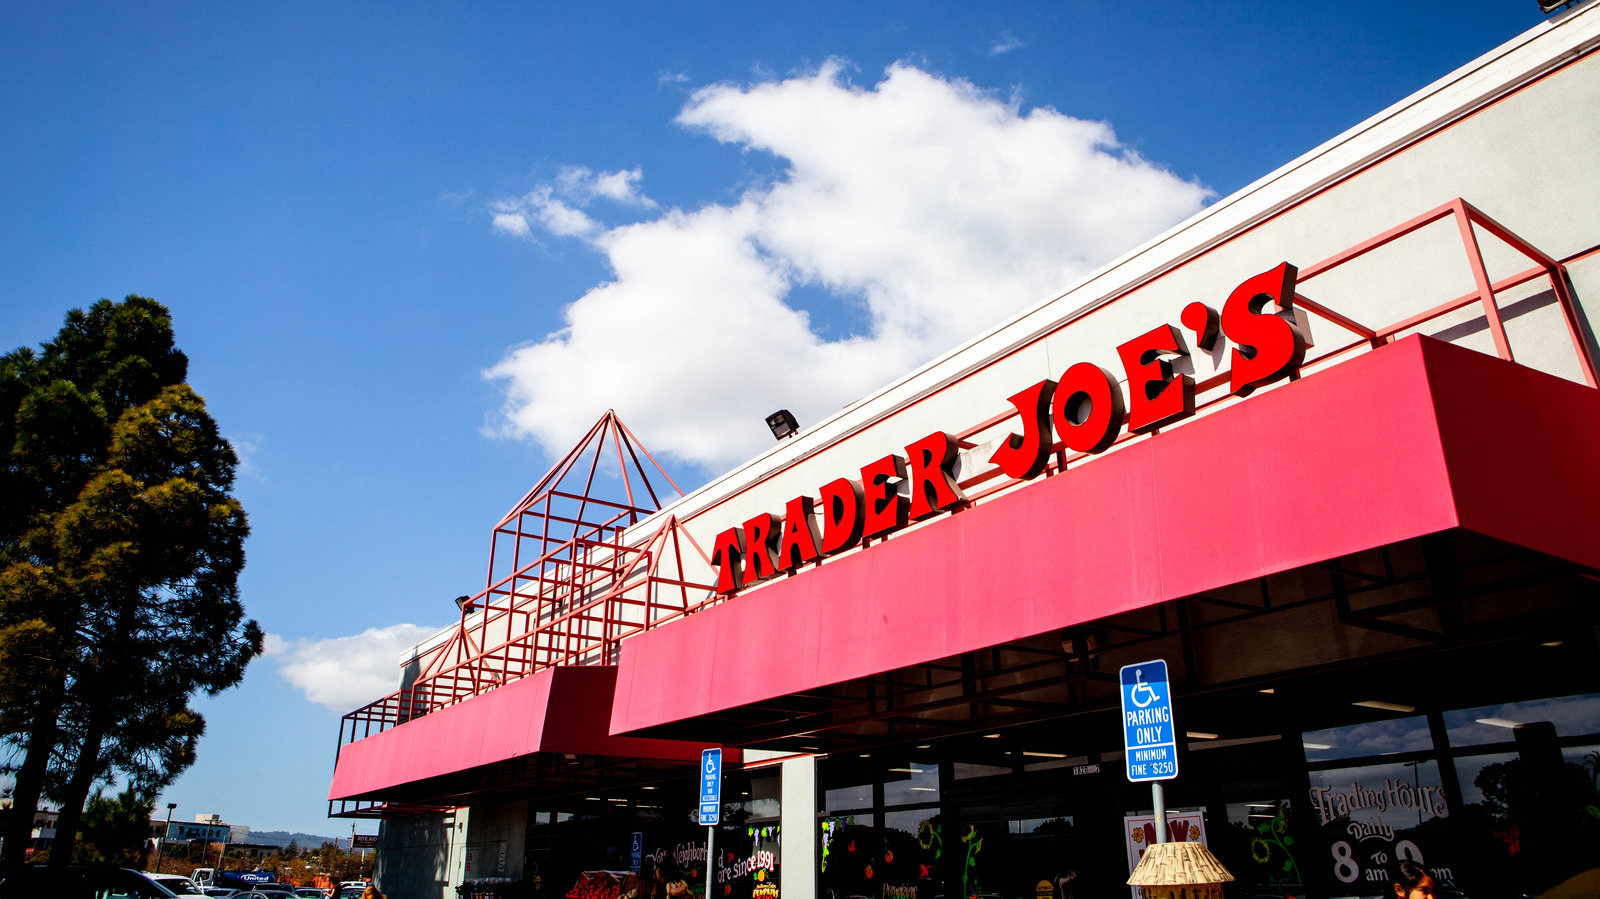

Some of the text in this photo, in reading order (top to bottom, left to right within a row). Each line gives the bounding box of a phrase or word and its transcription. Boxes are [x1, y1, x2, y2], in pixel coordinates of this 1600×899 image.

[712, 261, 1308, 596] TRADER JOE'S
[1127, 706, 1170, 727] PARKING
[1136, 726, 1163, 745] ONLY
[1135, 748, 1168, 762] MINIMUM
[1131, 761, 1174, 777] FINE $250
[1309, 778, 1450, 827] Trading Hours
[1347, 816, 1395, 843] Daily
[732, 855, 757, 879] since
[756, 850, 776, 873] 1991
[1331, 840, 1360, 884] 8
[1365, 868, 1390, 882] am
